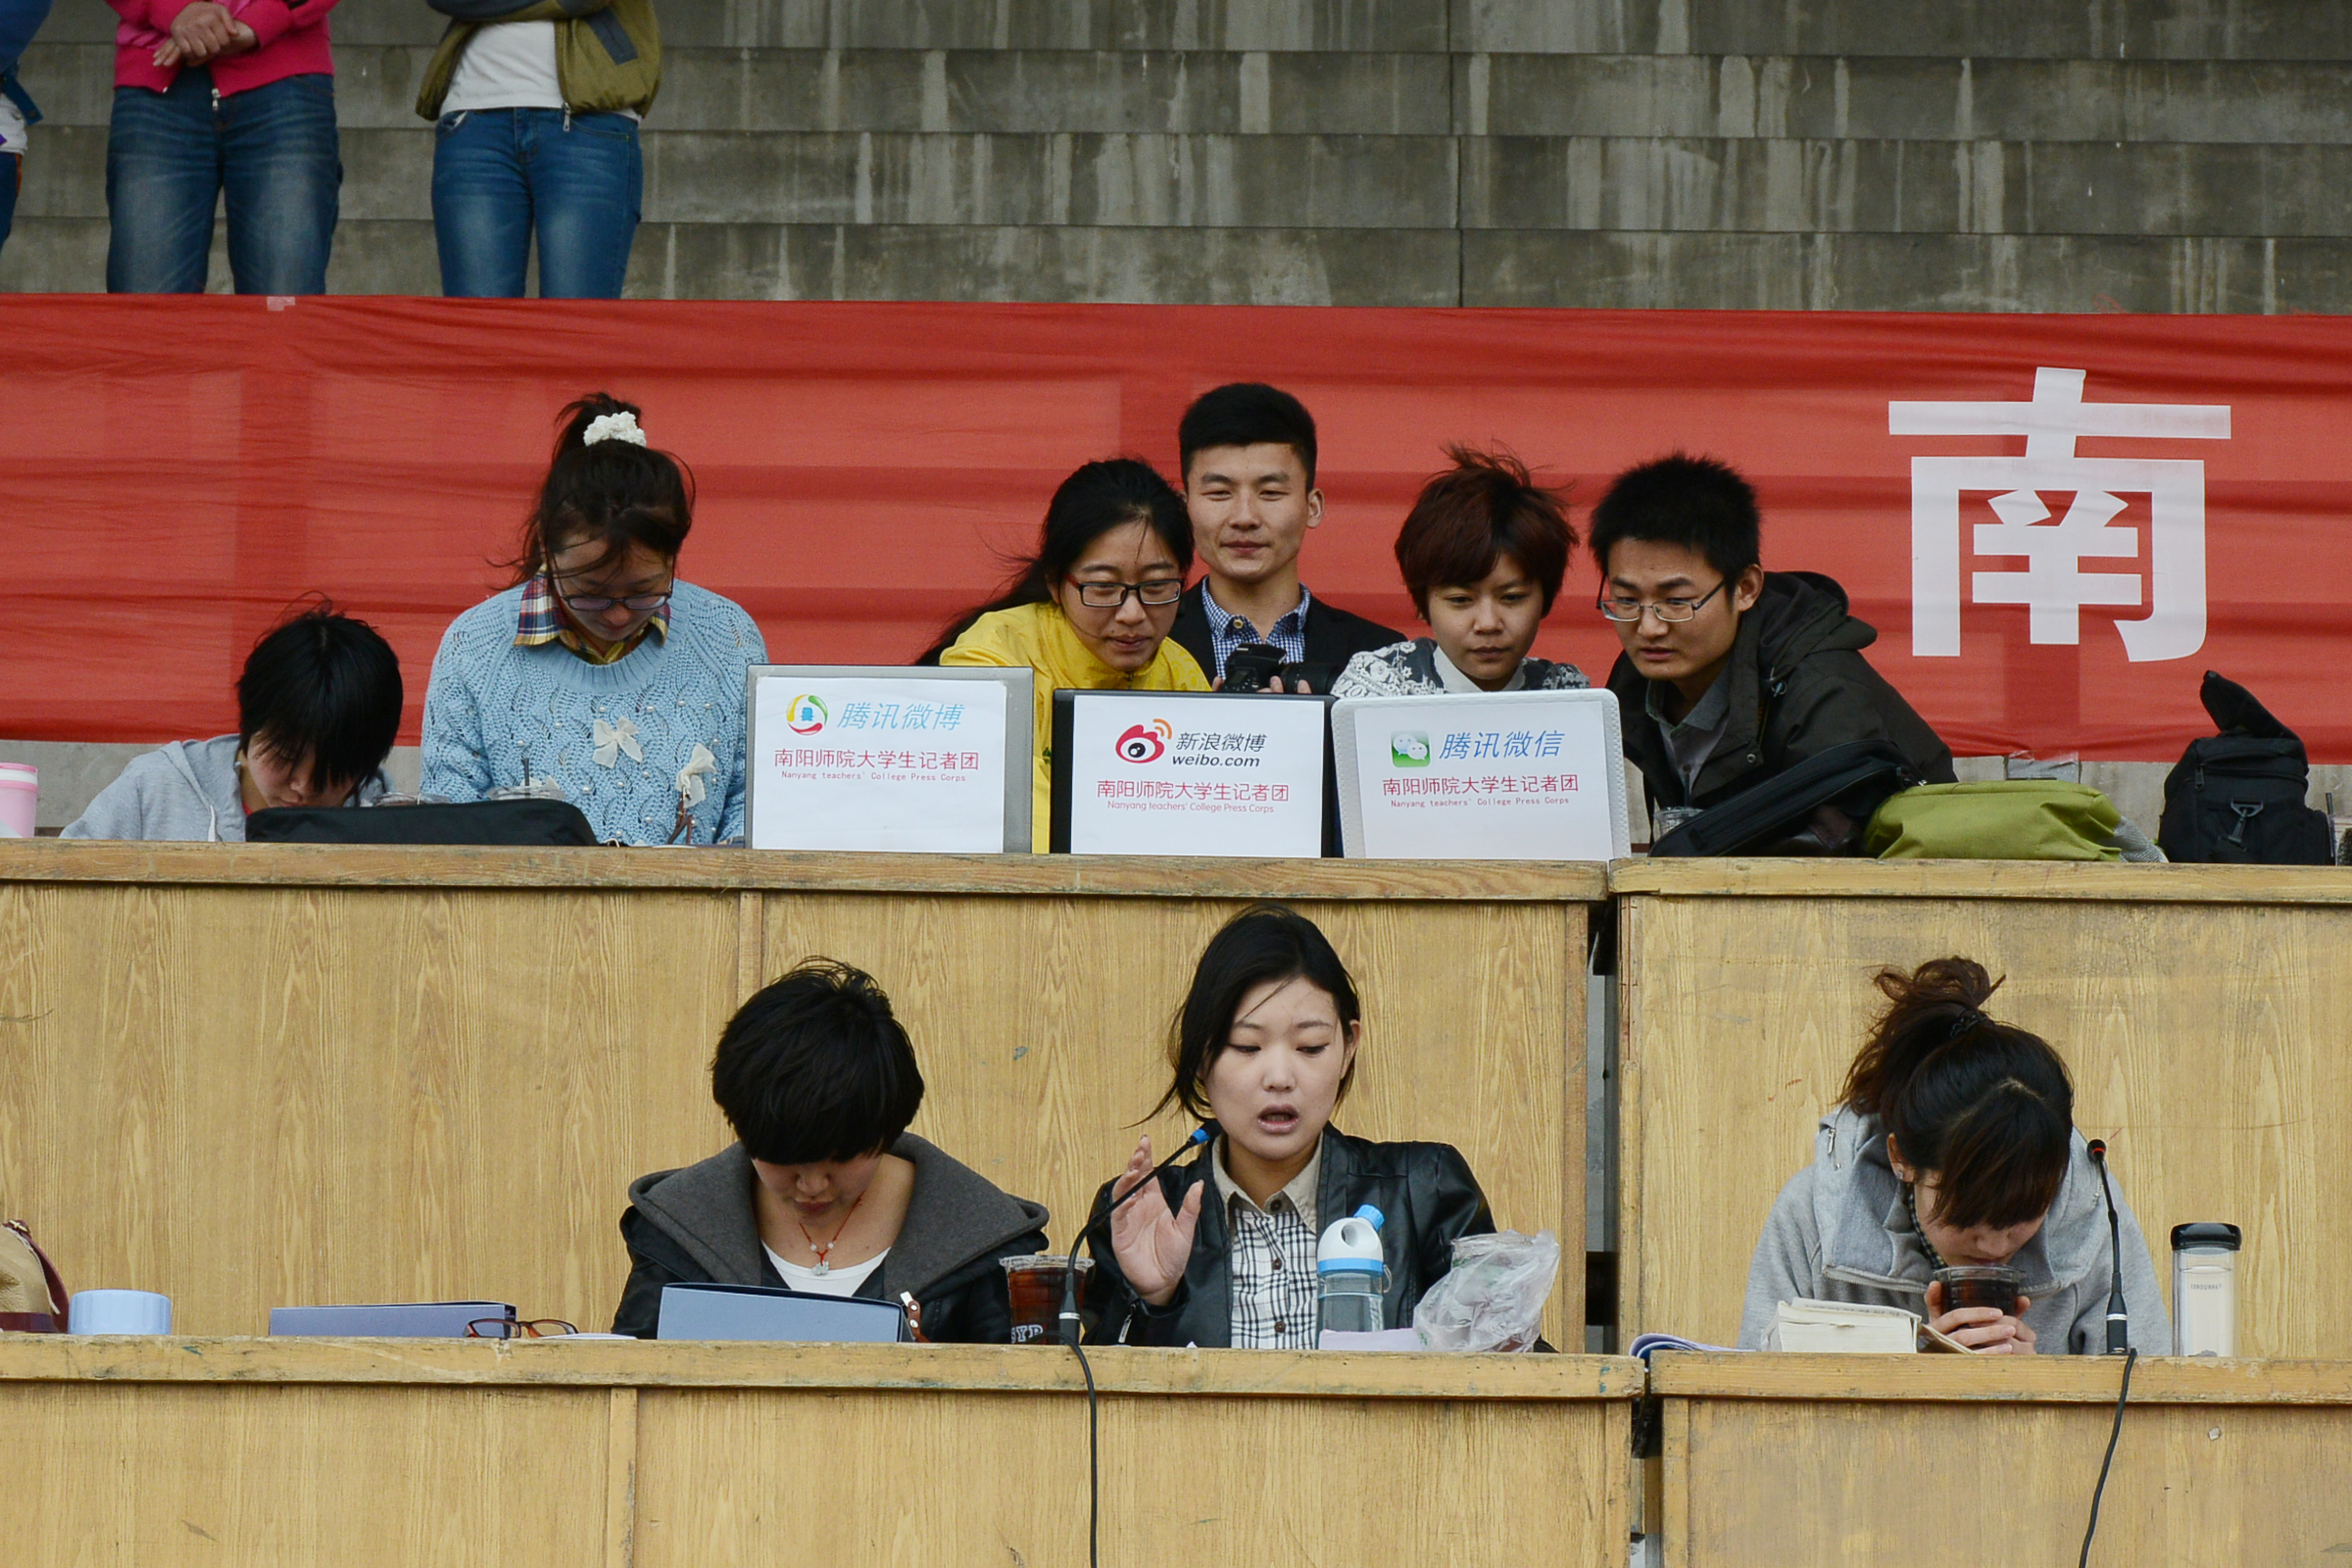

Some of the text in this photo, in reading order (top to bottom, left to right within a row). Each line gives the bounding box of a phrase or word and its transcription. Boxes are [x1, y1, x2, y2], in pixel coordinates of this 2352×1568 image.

[1888, 367, 2231, 662] 南
[837, 702, 965, 731] 腾讯微博
[1175, 731, 1267, 753] 新浪微博
[1439, 730, 1565, 760] 腾讯微信
[774, 748, 979, 771] 南阳师院大学生记者团
[1172, 754, 1260, 768] weibo.com
[781, 770, 817, 780] Nanyang
[871, 772, 906, 782] College
[910, 772, 936, 781] Press
[941, 773, 966, 782] Corps
[1382, 774, 1579, 797] 南阳师院大学生记者团
[1097, 779, 1290, 803] 南阳师院大学生记者团
[1391, 800, 1426, 808] Nanyang
[1477, 797, 1512, 807] College
[1515, 797, 1541, 806] Press
[1544, 796, 1569, 806] Corps
[1107, 800, 1147, 811] Nanyang
[1190, 803, 1222, 813] College
[1224, 804, 1248, 812] Press
[1250, 805, 1274, 814] Corps
